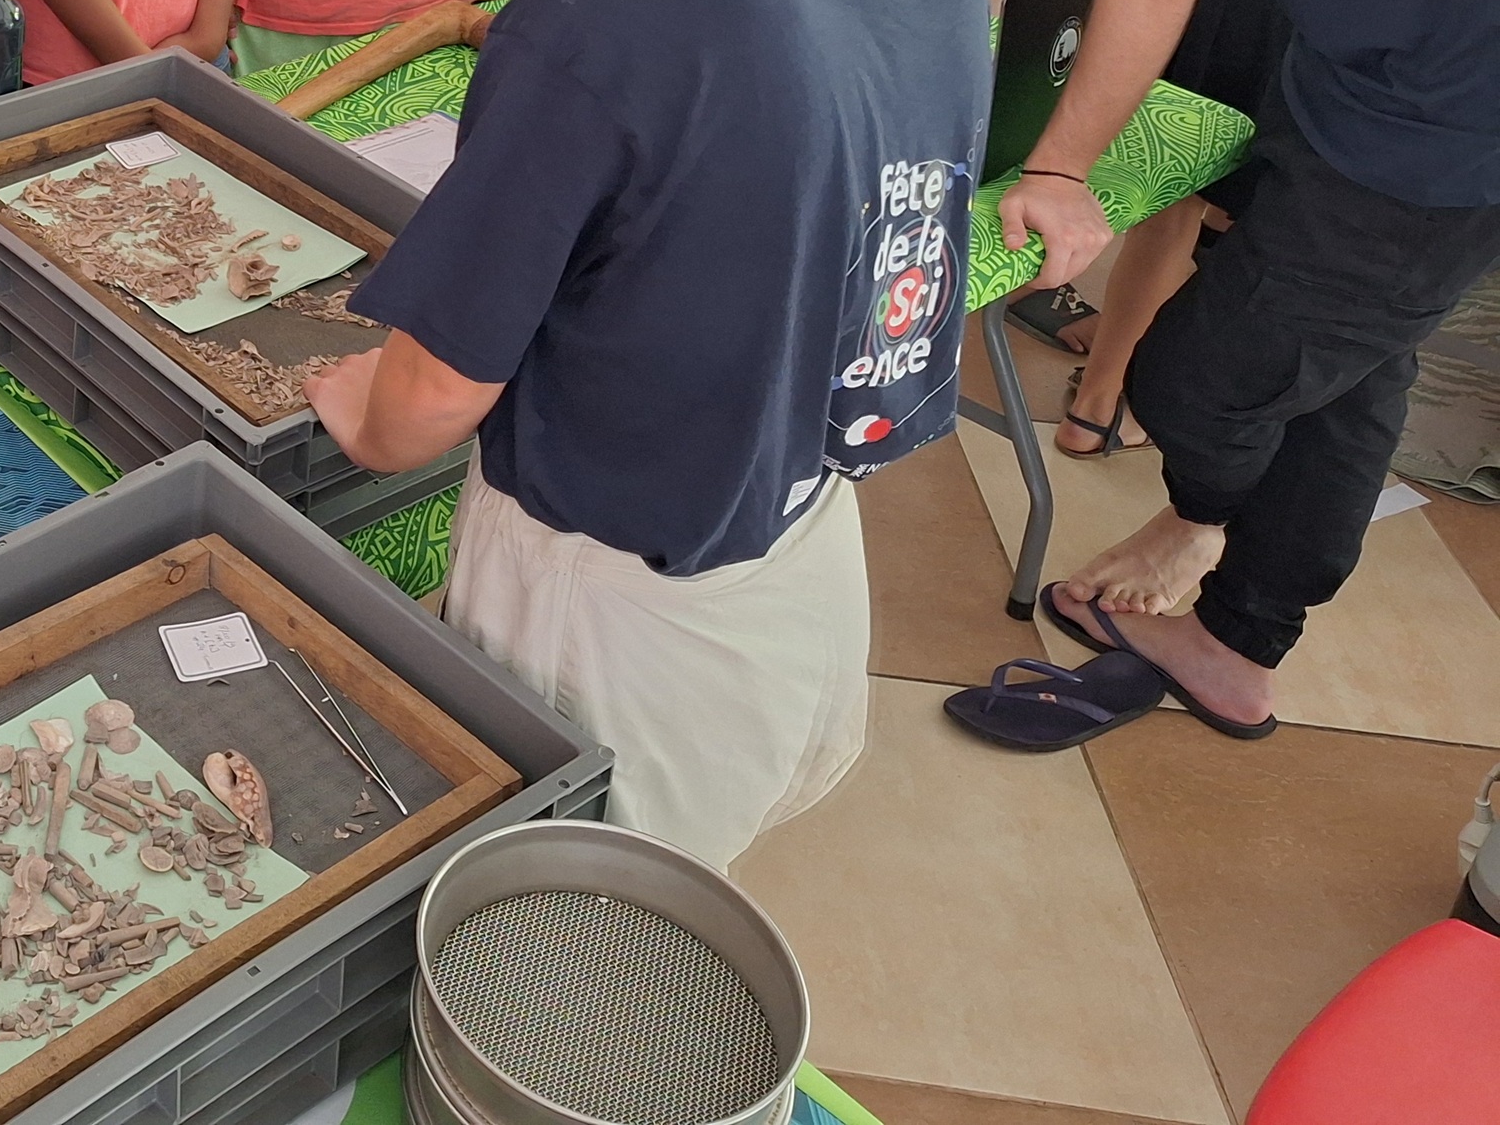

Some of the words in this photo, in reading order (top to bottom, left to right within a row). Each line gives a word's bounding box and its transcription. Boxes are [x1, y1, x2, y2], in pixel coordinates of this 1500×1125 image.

[880, 160, 943, 220] fête
[874, 225, 909, 281] de
[916, 215, 945, 266] la
[888, 266, 943, 326] Sci
[841, 337, 931, 388] ence
